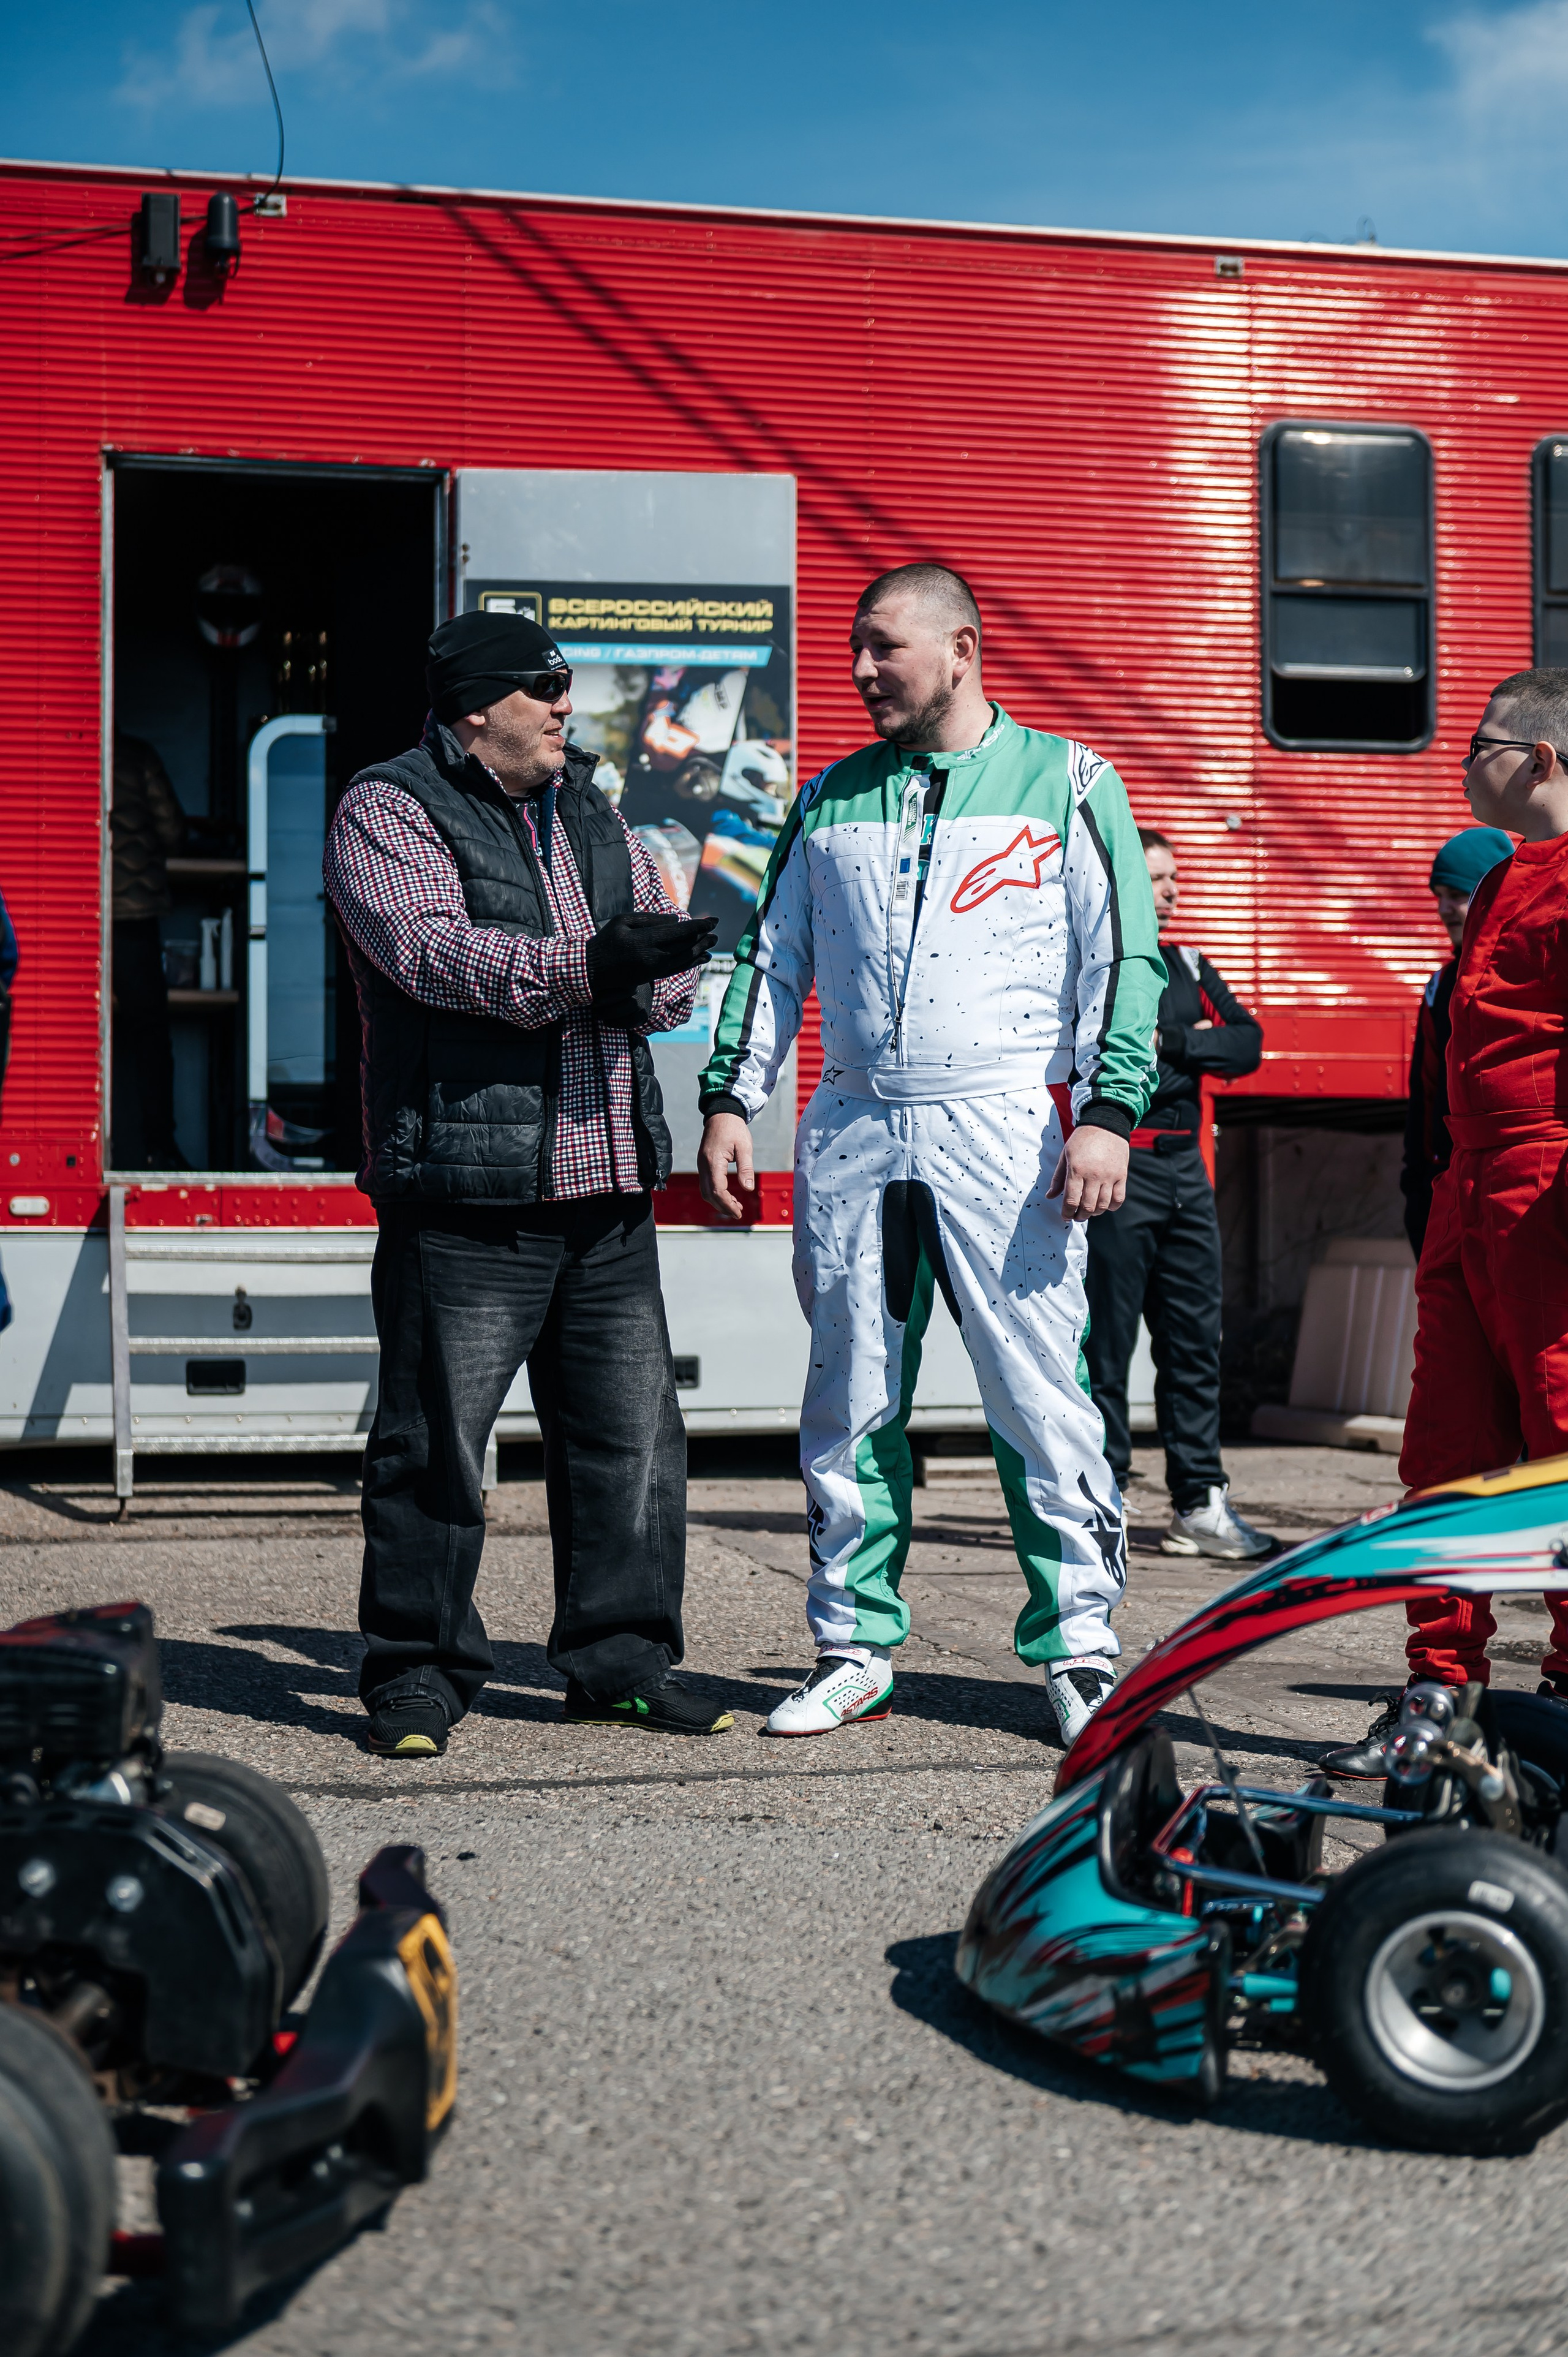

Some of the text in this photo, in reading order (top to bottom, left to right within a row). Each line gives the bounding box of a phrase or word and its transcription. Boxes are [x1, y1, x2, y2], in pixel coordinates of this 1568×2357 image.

[548, 598, 774, 618] ВСЕРОССИЙСКИЙ
[548, 616, 774, 633] КАРТИНГОВЫЙ ТУРНИР
[561, 646, 601, 658] CING
[614, 646, 757, 661] ГАЗПРОМ-ДЕТЯМ
[840, 1686, 878, 1717] ASTARS
